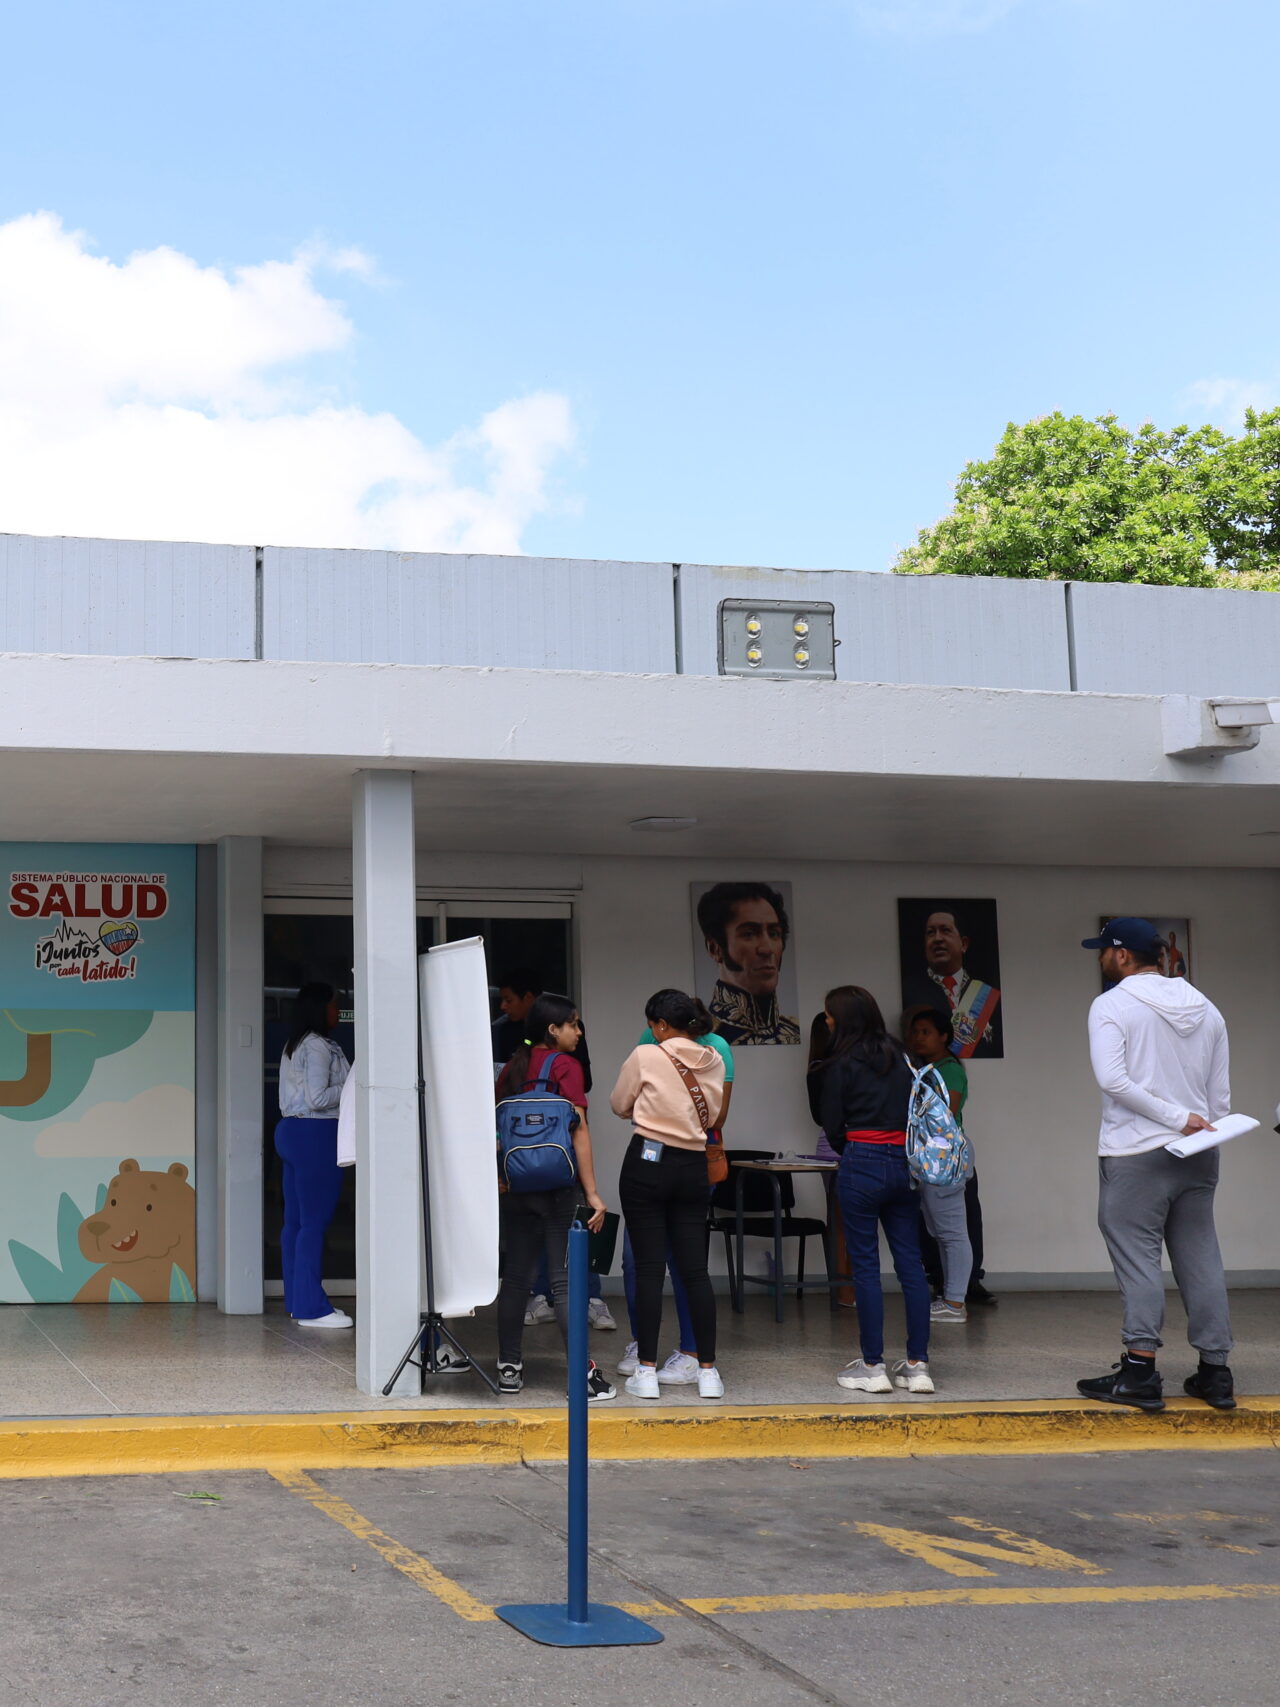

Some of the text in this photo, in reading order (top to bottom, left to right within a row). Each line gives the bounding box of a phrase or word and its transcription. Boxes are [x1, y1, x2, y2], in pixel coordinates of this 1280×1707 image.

[11, 872, 165, 884] SISTEMA PÚBLICO NACIONAL DE
[9, 882, 167, 919] SALUD
[57, 962, 81, 977] cada
